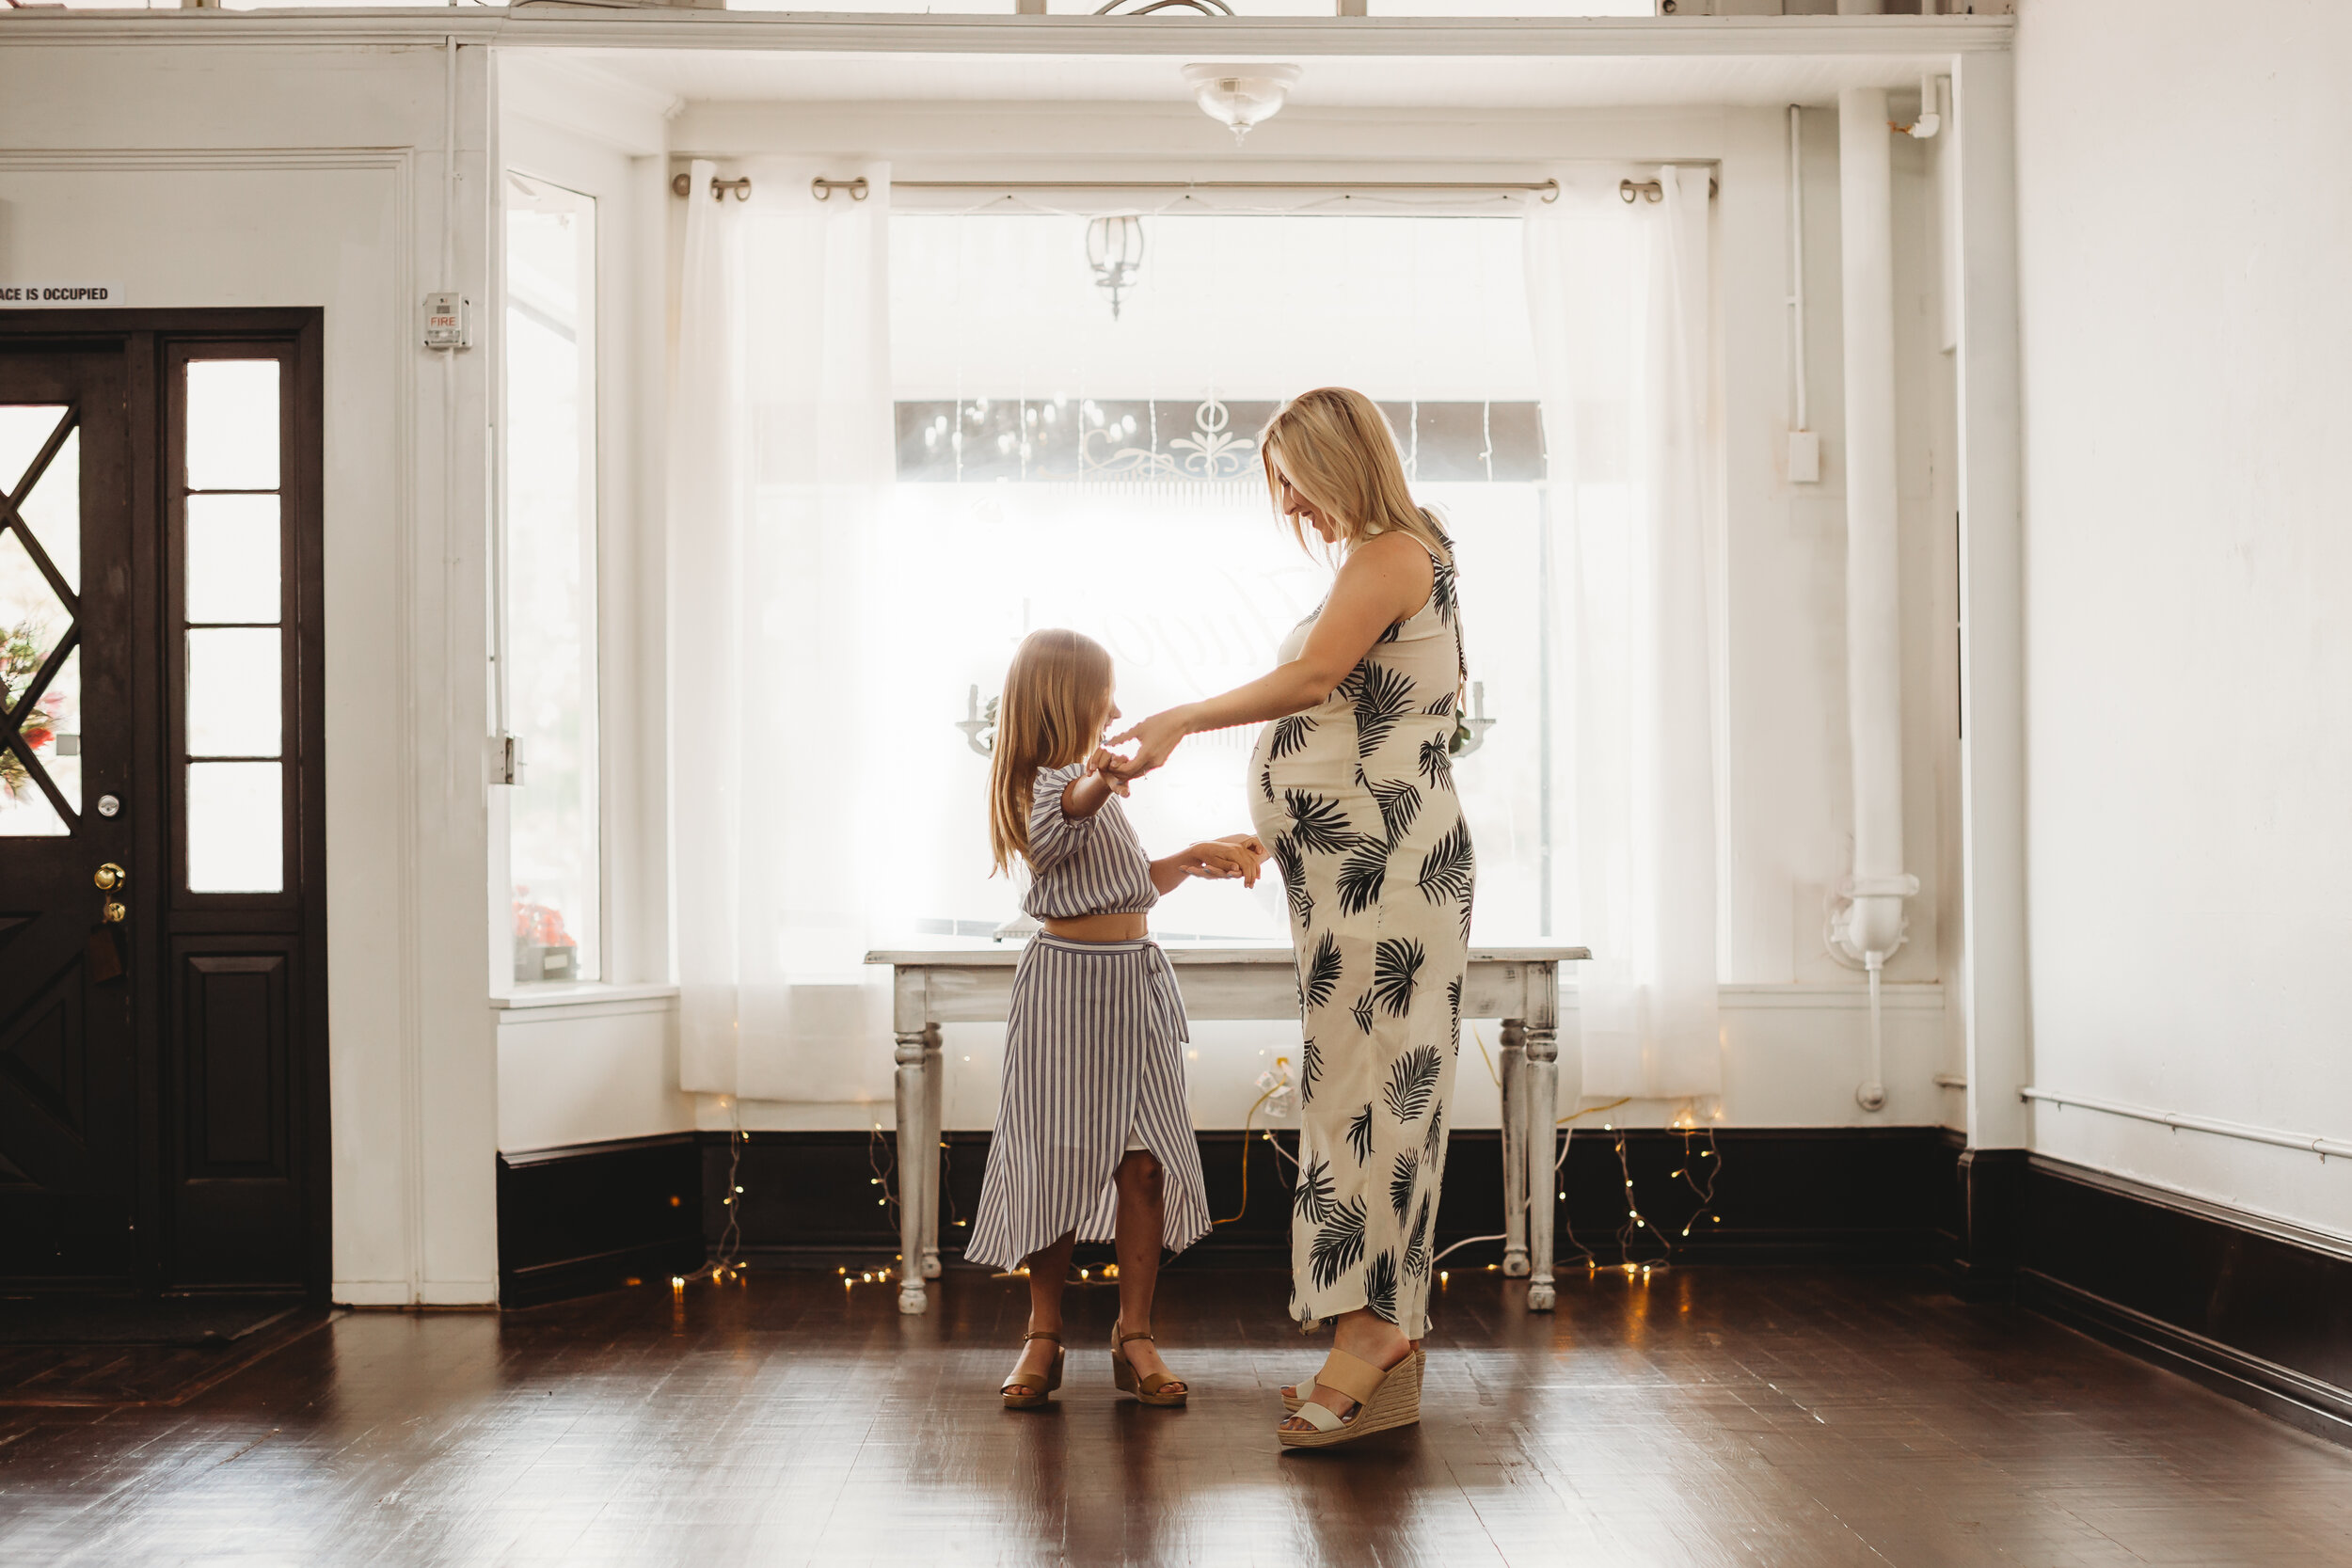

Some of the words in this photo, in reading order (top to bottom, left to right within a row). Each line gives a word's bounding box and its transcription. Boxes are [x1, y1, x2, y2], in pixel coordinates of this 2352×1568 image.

[26, 288, 39, 300] IS
[43, 288, 108, 300] OCCUPIED
[430, 316, 456, 326] FIRE
